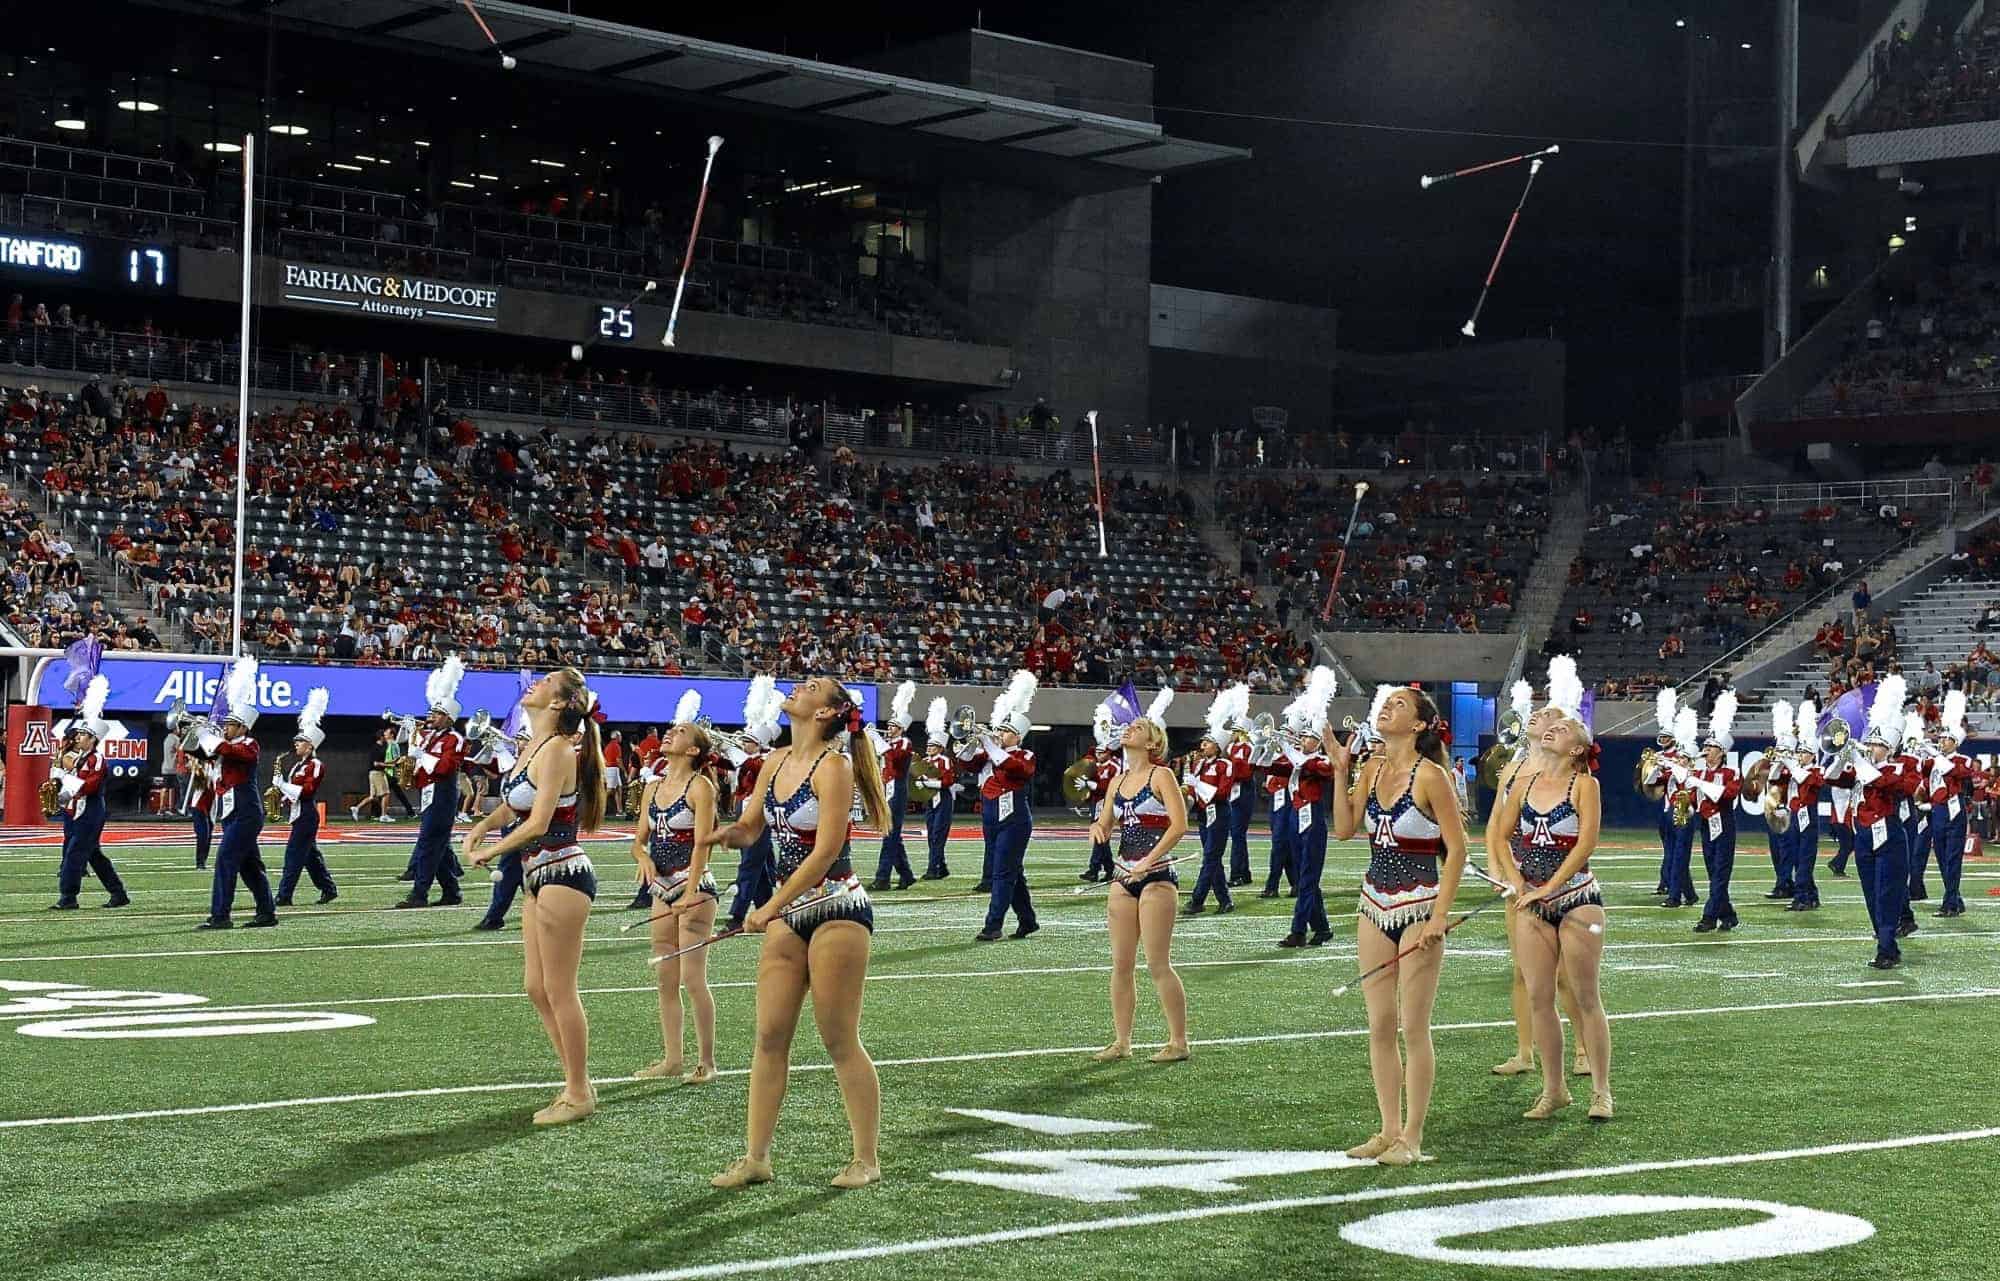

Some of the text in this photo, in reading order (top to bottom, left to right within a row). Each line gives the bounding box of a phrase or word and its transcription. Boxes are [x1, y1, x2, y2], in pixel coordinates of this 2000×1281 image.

[130, 249, 163, 285] 17
[361, 299, 425, 319] Attorneys
[600, 306, 633, 338] 25
[19, 721, 51, 755] A
[1374, 814, 1399, 849] A
[1531, 816, 1556, 847] A
